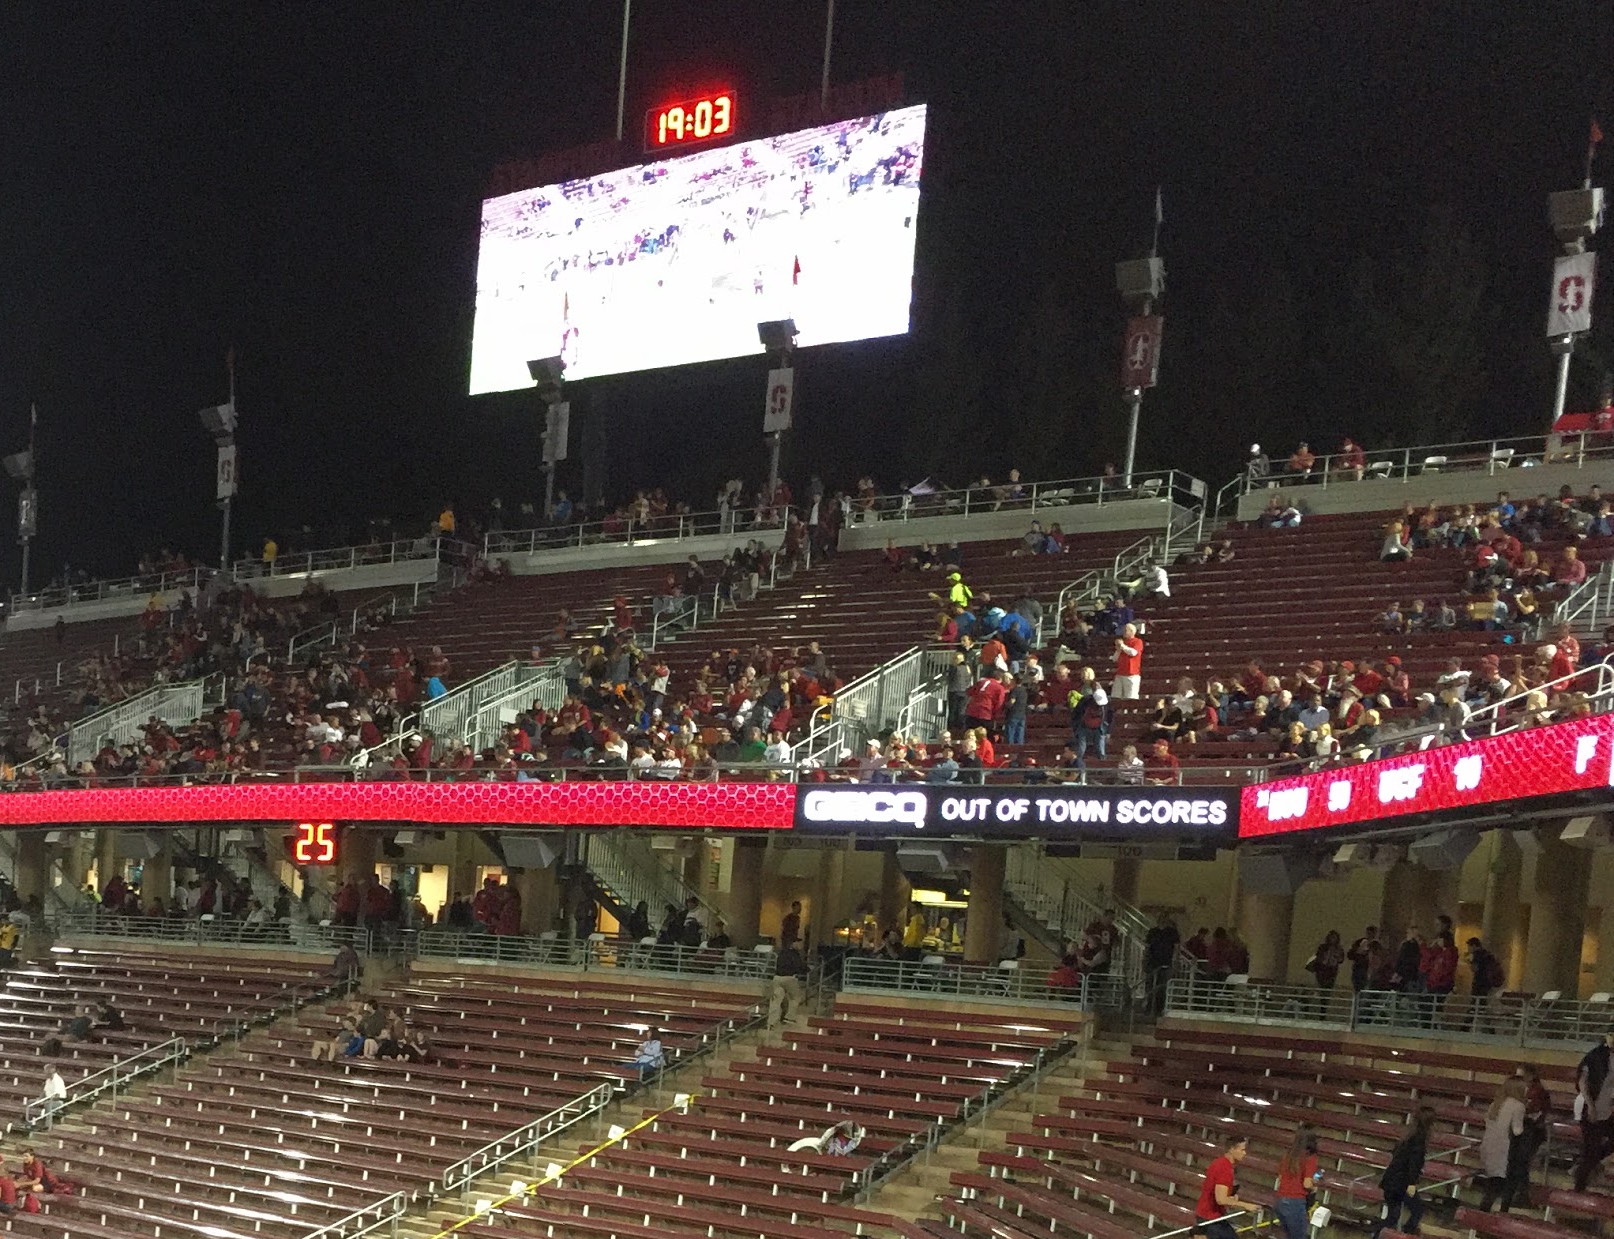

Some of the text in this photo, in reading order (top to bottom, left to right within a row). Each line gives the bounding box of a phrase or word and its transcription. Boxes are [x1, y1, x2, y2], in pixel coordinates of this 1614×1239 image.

[659, 97, 731, 143] 19:03
[941, 799, 1227, 825] OUT OF TOWN SCORES
[296, 823, 334, 861] 25
